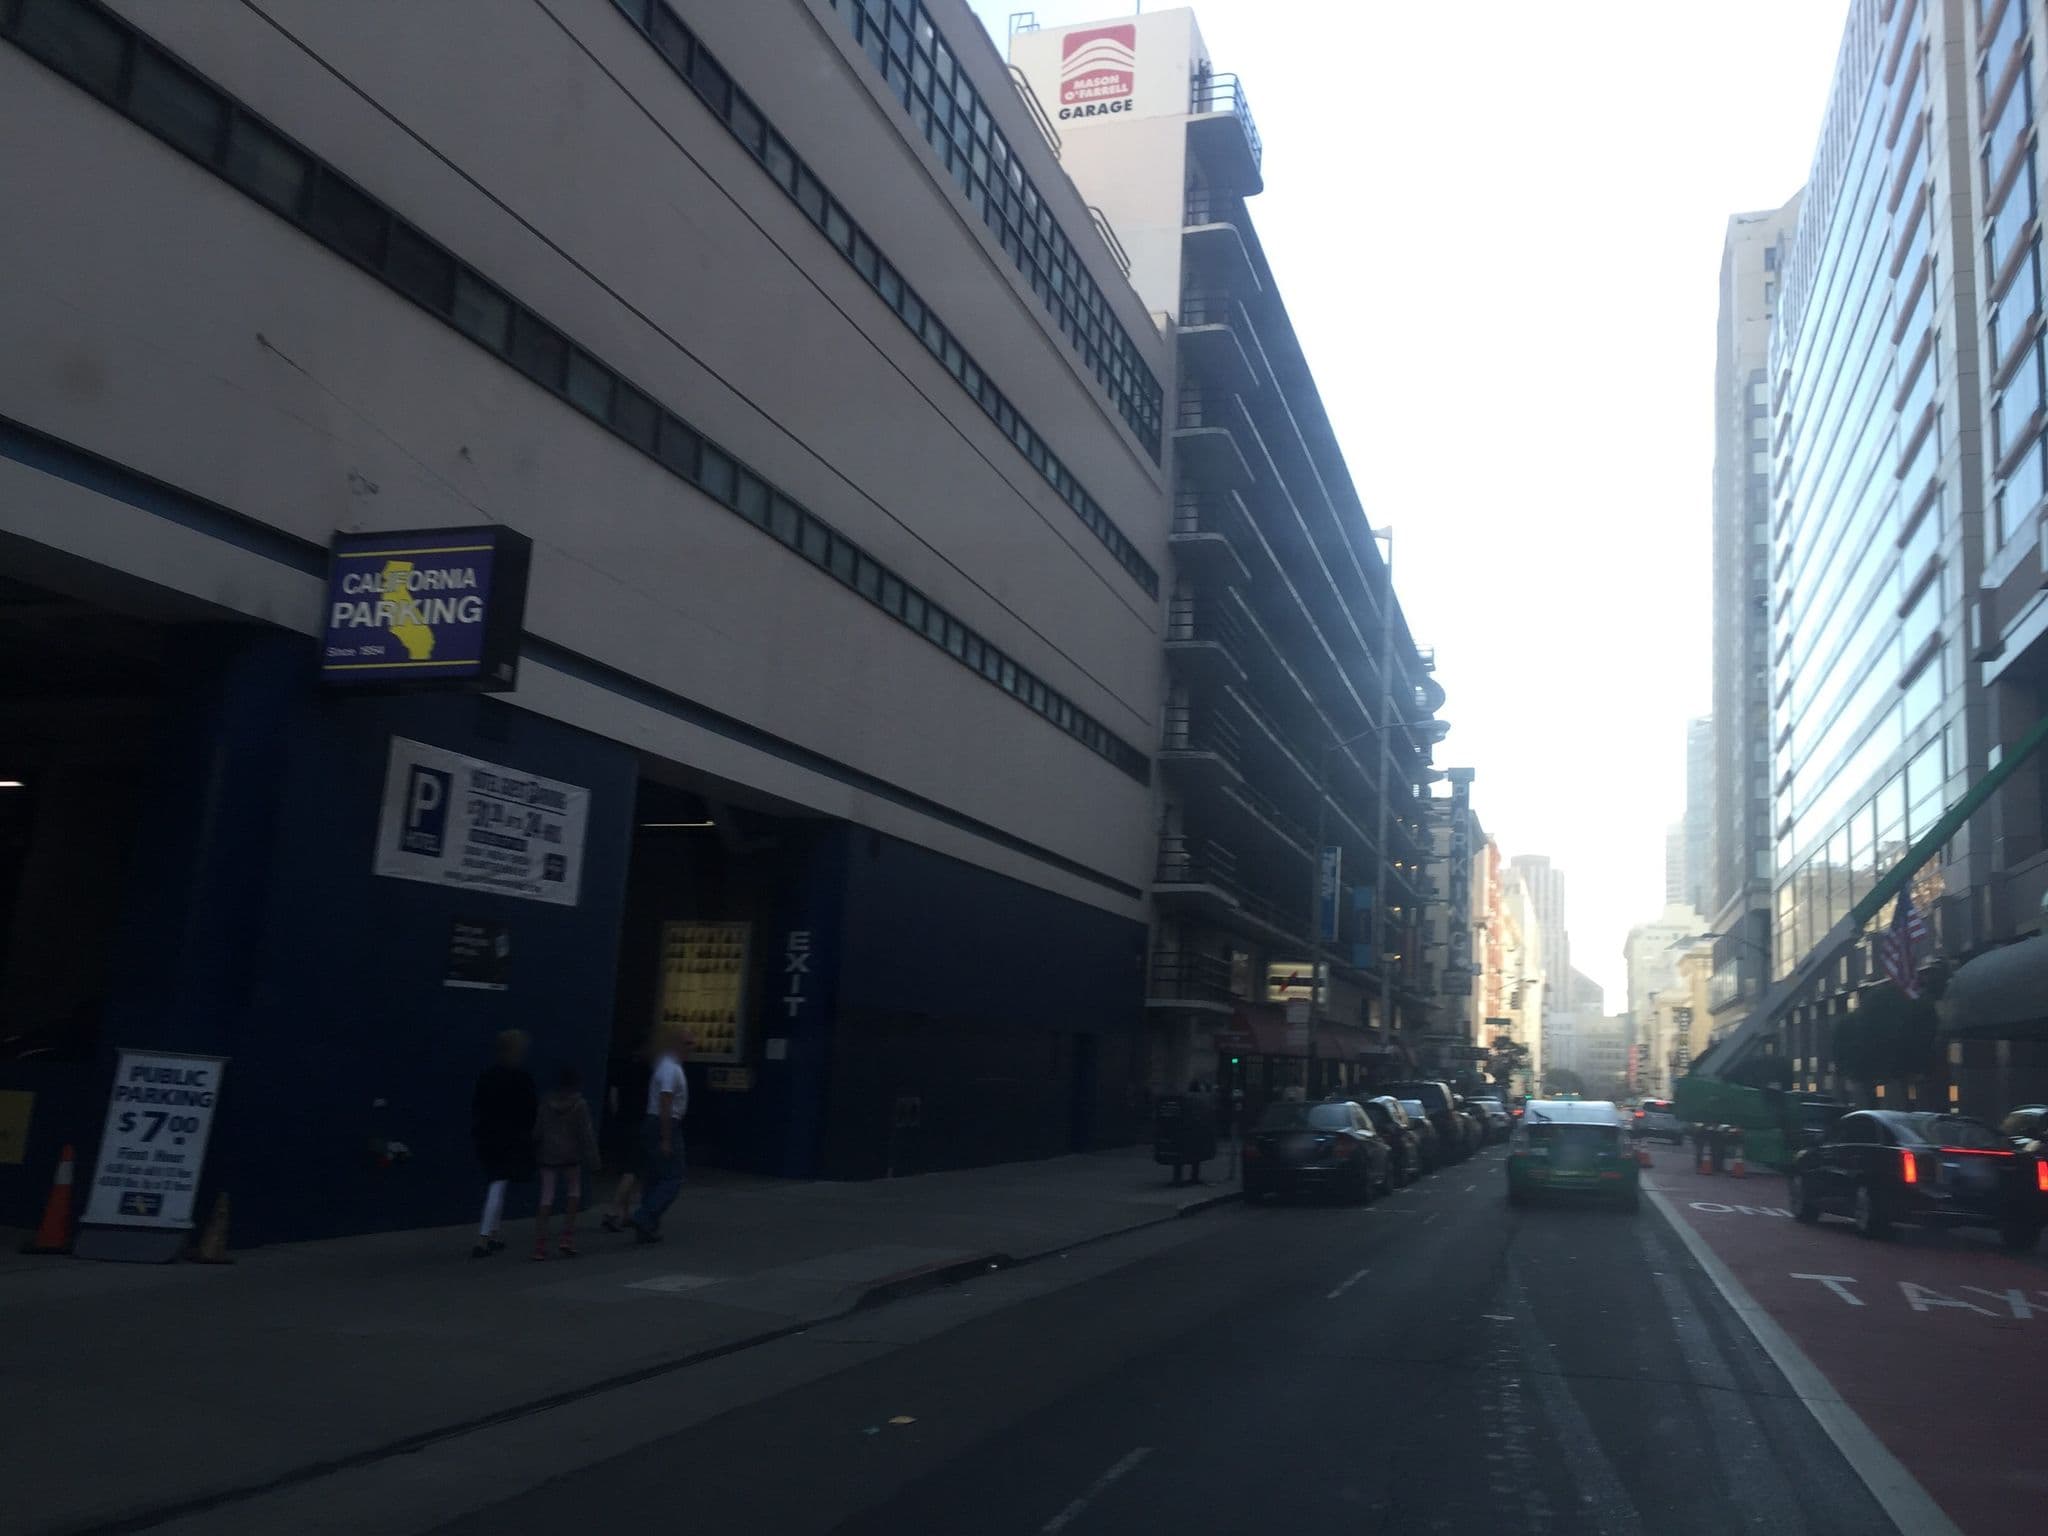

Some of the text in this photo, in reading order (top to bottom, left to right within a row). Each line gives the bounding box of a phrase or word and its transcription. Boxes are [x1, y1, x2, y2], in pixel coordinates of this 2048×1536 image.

[1064, 83, 1129, 100] O'FARRELL
[1073, 74, 1119, 89] MASON
[1059, 99, 1133, 120] GARAGE
[342, 568, 479, 594] CALIFORNIA
[330, 596, 484, 629] PARKING
[784, 930, 812, 1017] EXIT
[131, 1066, 208, 1087] PUBLIC
[117, 1085, 213, 1108] PARKING
[1788, 1272, 2048, 1319] TAX
